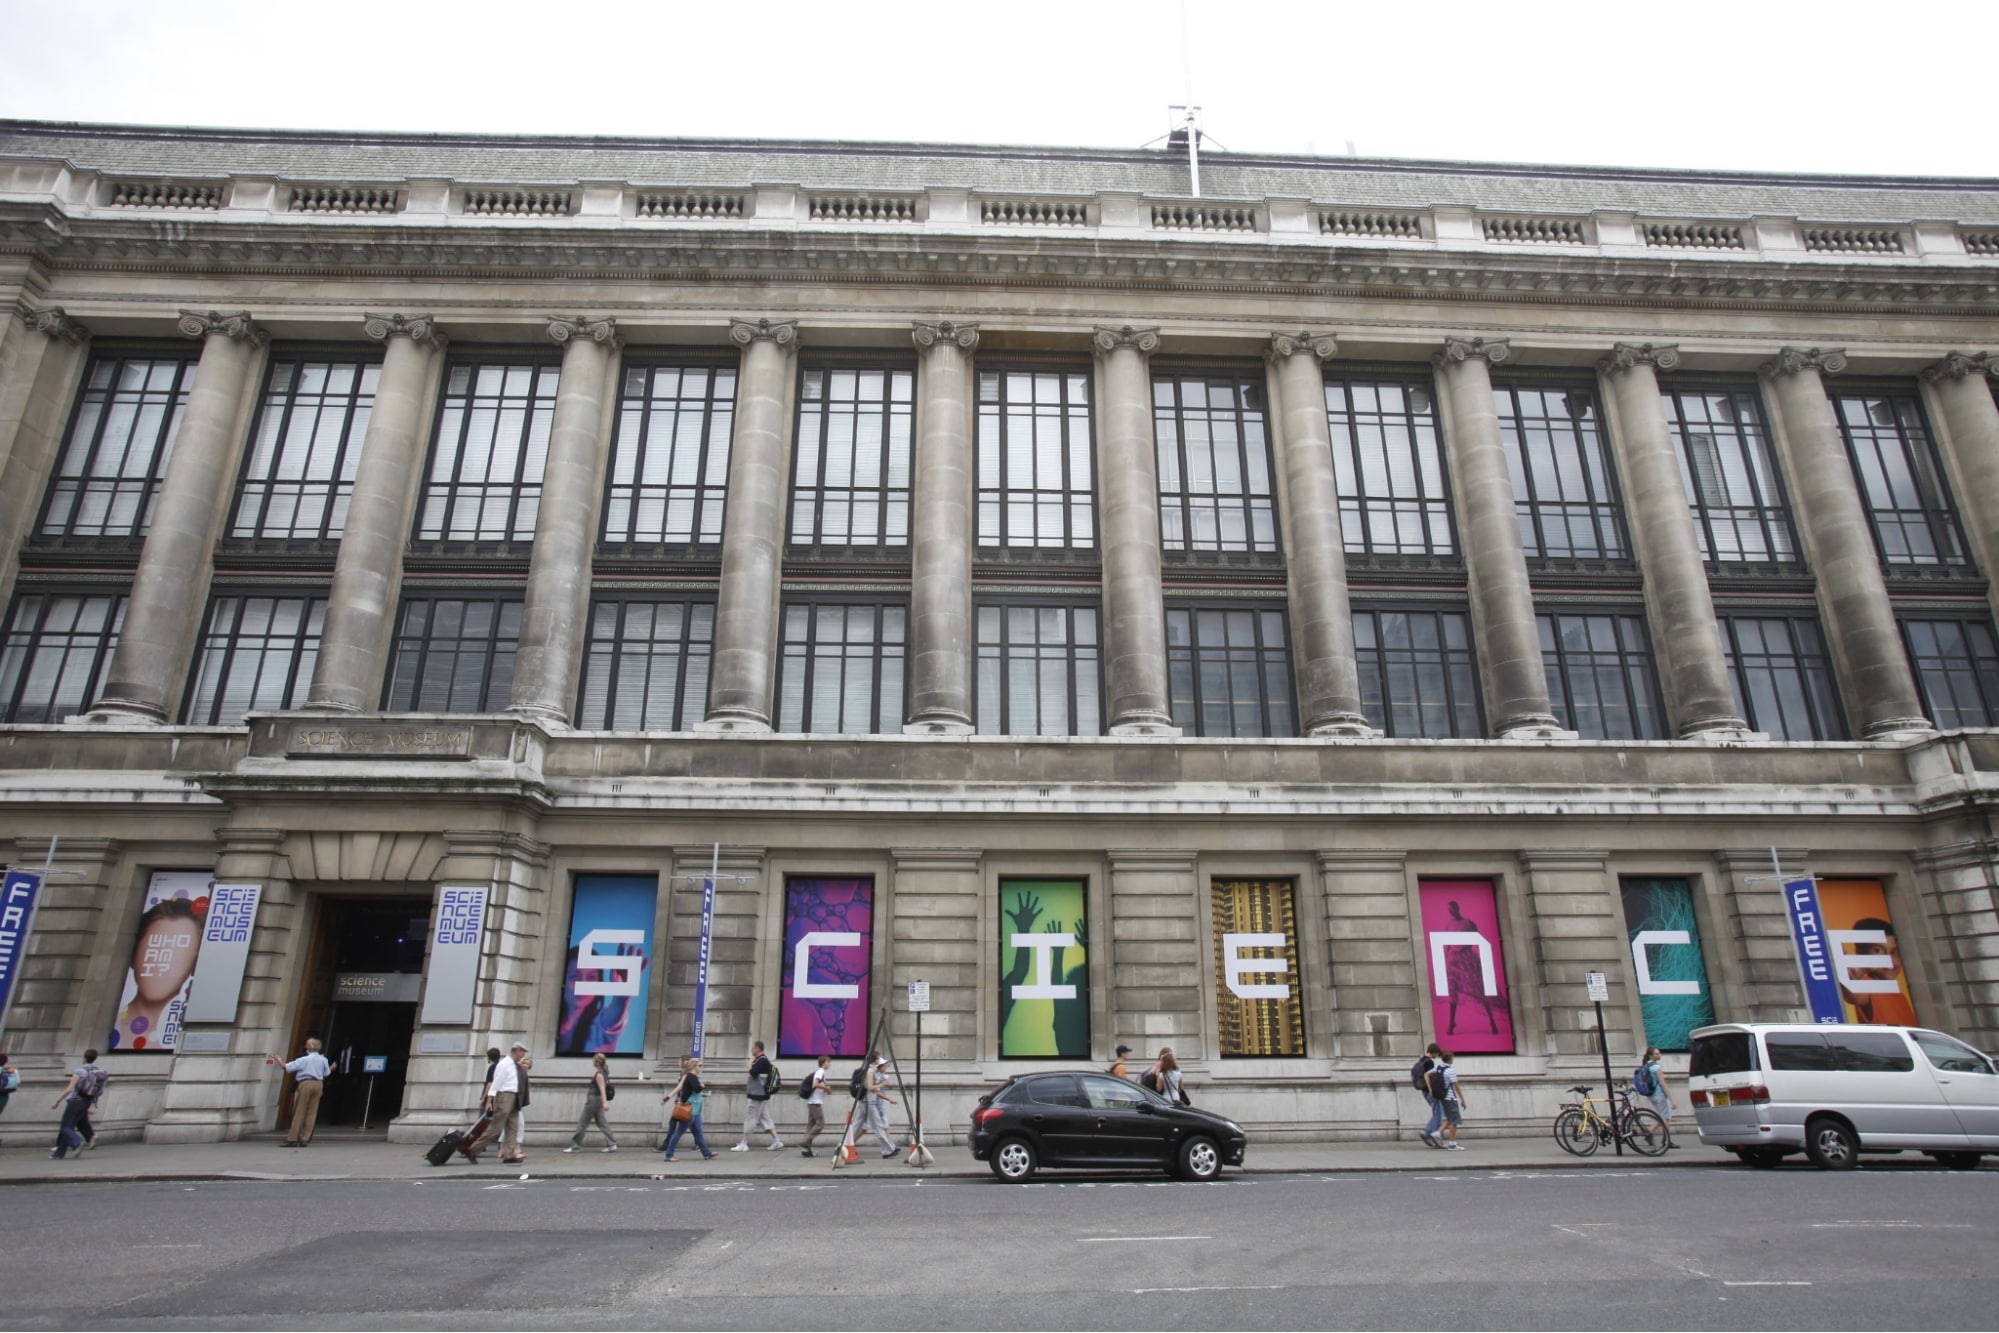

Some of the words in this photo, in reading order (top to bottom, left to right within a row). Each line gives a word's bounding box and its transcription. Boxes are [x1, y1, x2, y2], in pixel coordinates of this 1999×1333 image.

[299, 731, 373, 746] SCIENCE
[387, 732, 461, 748] MUSEUM
[210, 916, 250, 928] MUS
[440, 918, 479, 930] MUS
[207, 930, 247, 942] EUM
[438, 931, 477, 944] EUM
[699, 888, 711, 984] FREE
[1793, 888, 1828, 980] FREE
[148, 934, 192, 948] WHO
[144, 949, 173, 962] AM
[140, 963, 171, 977] I?
[574, 929, 645, 996] S
[793, 932, 861, 999] C
[1011, 933, 1077, 999] I
[1223, 933, 1290, 999] E
[1632, 930, 1700, 995] C
[1827, 930, 1901, 993] E
[340, 975, 386, 986] science
[338, 986, 384, 996] museum
